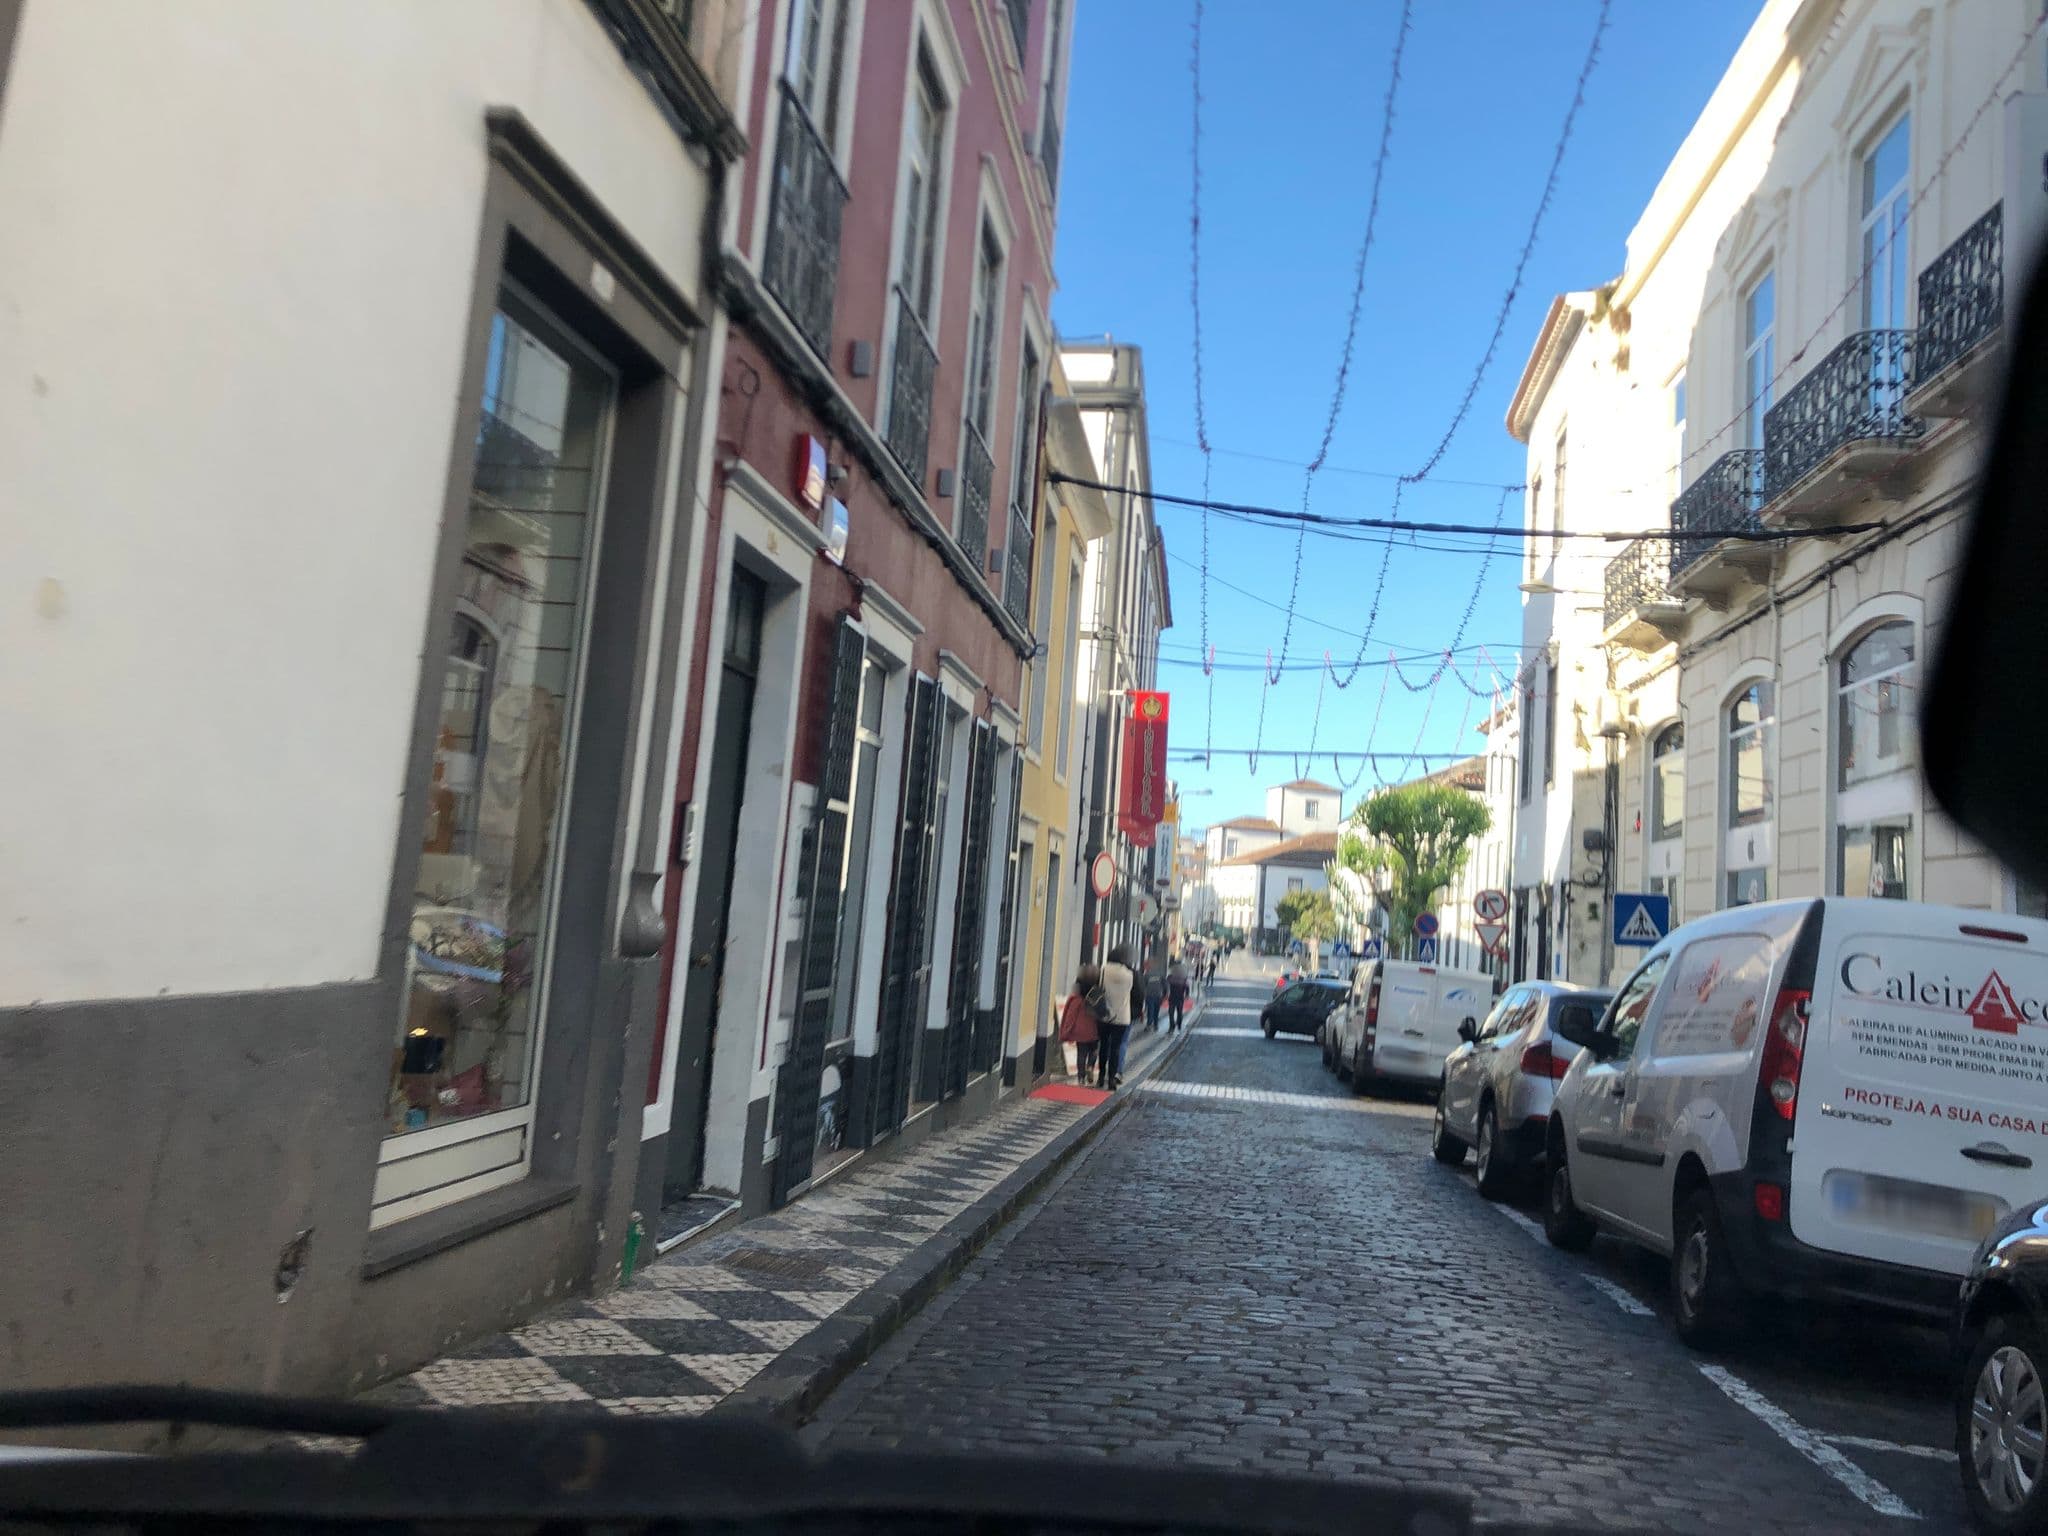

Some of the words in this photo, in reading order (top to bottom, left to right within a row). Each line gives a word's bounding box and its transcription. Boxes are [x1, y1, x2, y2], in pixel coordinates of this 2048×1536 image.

[1852, 1031, 1874, 1043] SEM
[1876, 1035, 1928, 1051] EMENDAS
[1937, 1043, 1960, 1057] SEM
[1962, 1048, 2028, 1067] PROBLEMAS
[2030, 1058, 2045, 1071] DE
[1897, 1024, 1913, 1035] DE
[1971, 1032, 2018, 1051] LACADO
[2020, 1041, 2036, 1055] EM
[1859, 1045, 1928, 1064] FABRICADAS
[1929, 1056, 1953, 1068] POR
[1955, 1060, 1996, 1076] MEDIDA
[1998, 1067, 2034, 1082] JUNTO
[1844, 1087, 1926, 1115] PROTEJA
[1930, 1103, 1943, 1118] A
[1947, 1106, 1984, 1126] SUA
[1988, 1113, 2037, 1135] CASA
